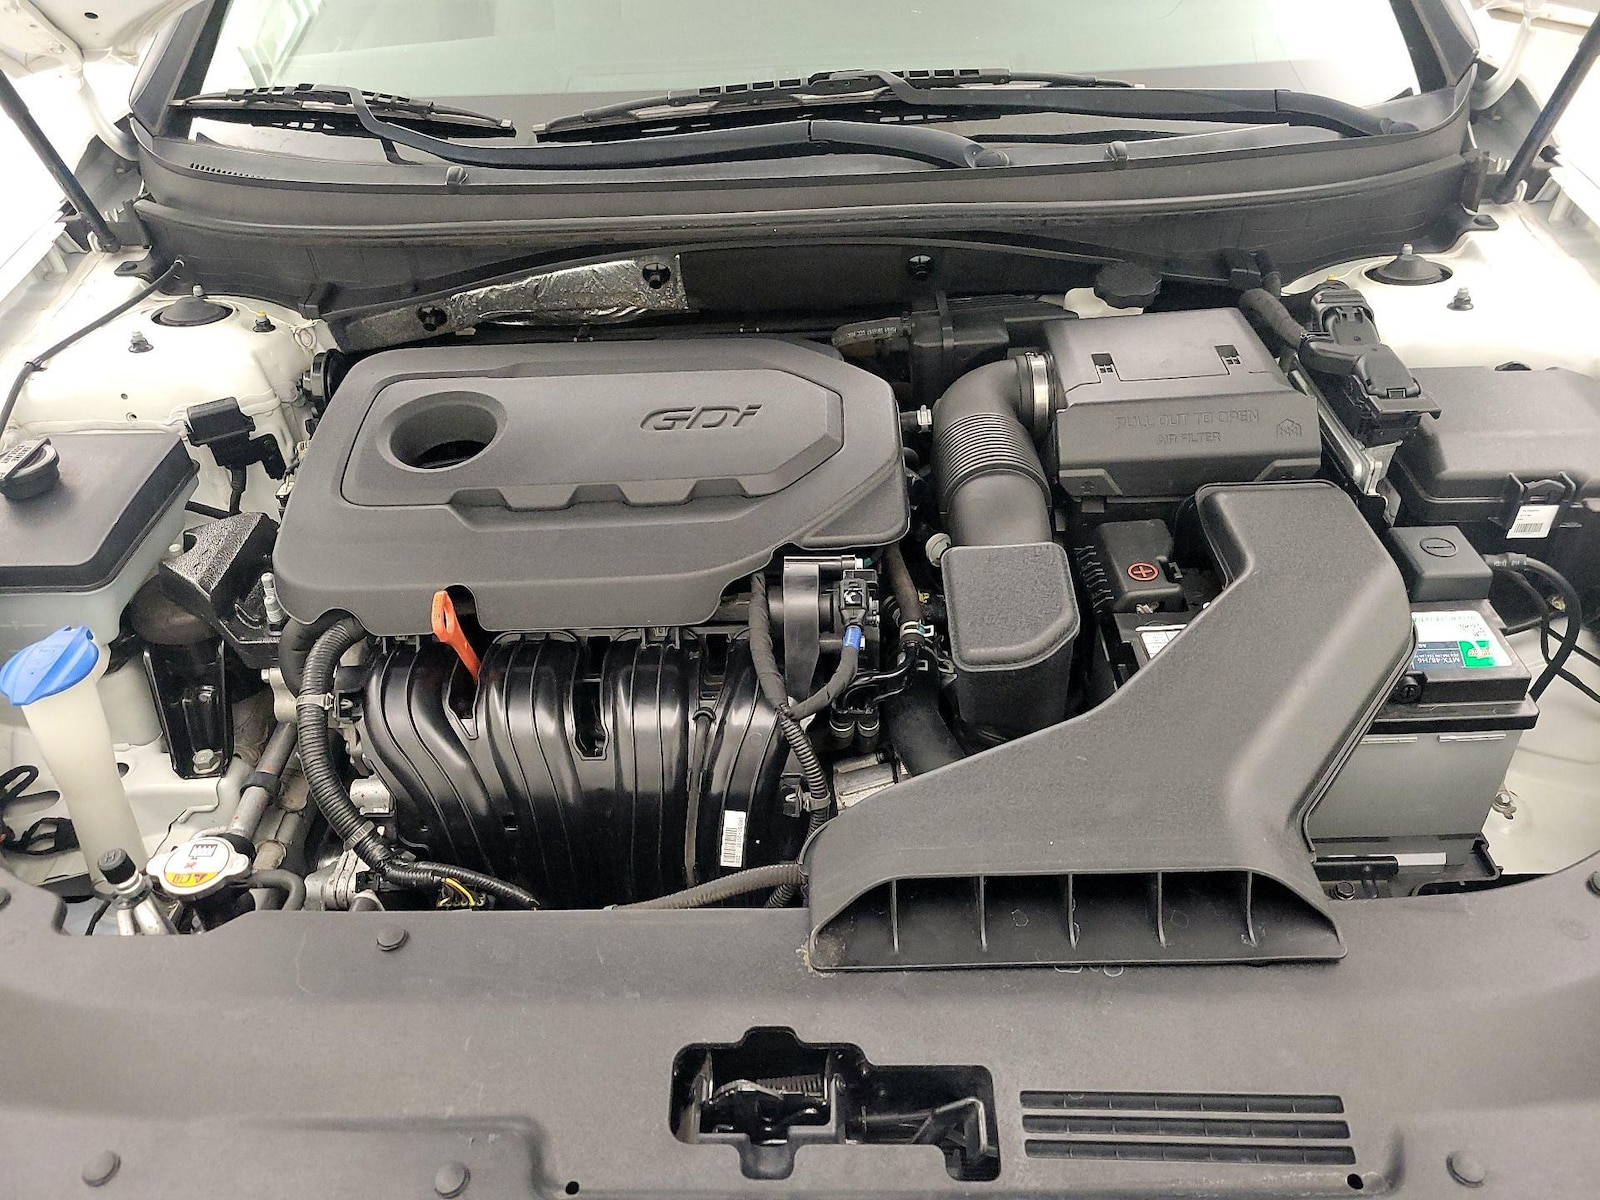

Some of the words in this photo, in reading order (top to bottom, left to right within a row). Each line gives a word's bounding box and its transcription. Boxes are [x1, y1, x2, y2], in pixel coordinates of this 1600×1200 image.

[1115, 415, 1155, 430] PULL
[1158, 413, 1189, 427] OUT
[1194, 411, 1214, 426] TO
[1217, 408, 1260, 425] OPEN
[1156, 433, 1178, 446] AIR
[1180, 431, 1221, 444] FILTER
